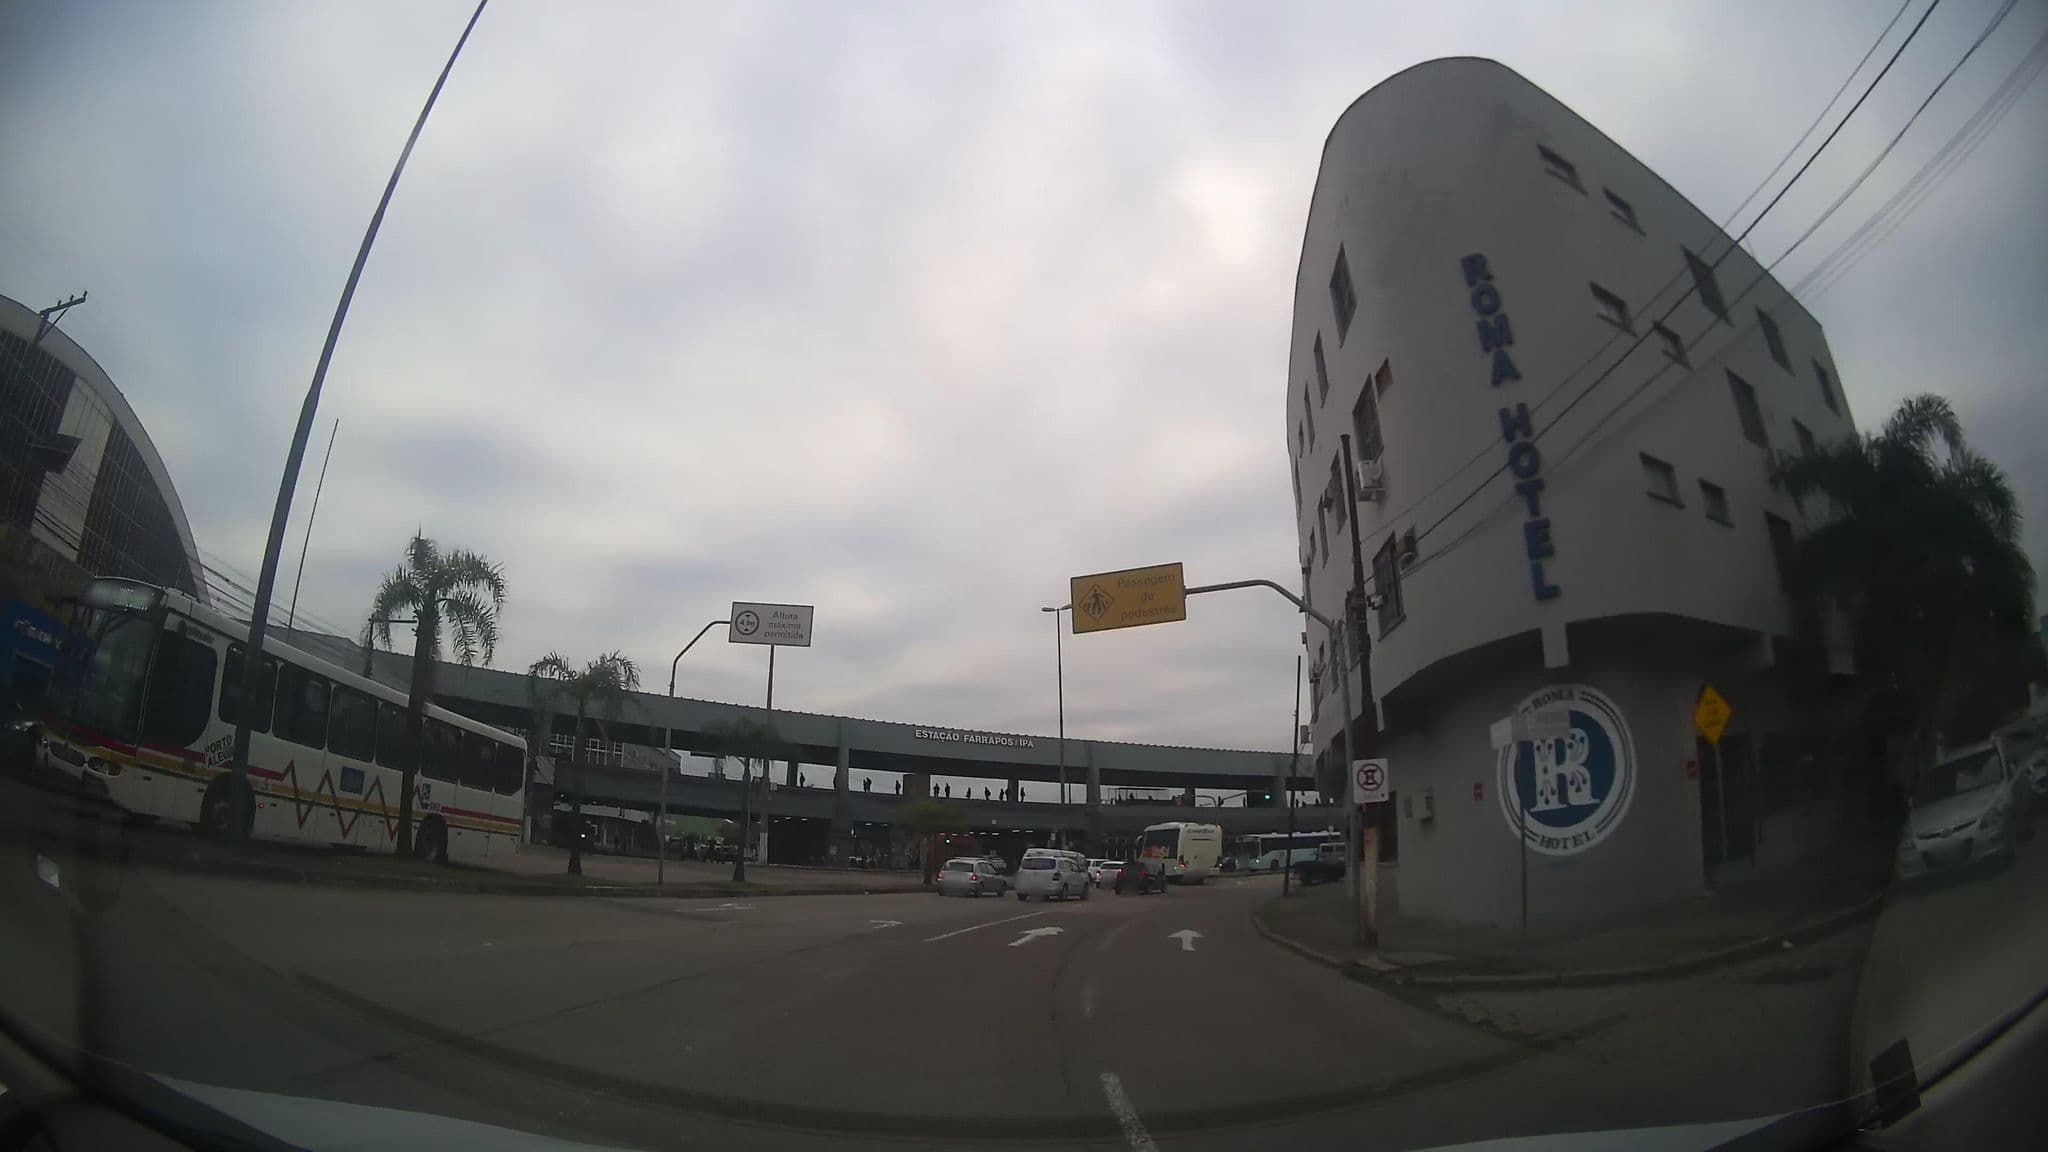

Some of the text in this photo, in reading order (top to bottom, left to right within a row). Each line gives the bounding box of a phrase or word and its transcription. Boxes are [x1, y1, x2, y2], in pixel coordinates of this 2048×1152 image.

[1460, 253, 1562, 601] ROMA HOTEL
[772, 611, 799, 621] Altura
[763, 630, 804, 640] permitida
[1531, 688, 1576, 708] ROMA
[205, 735, 232, 757] PORTO
[1538, 830, 1595, 851] HOTEL
